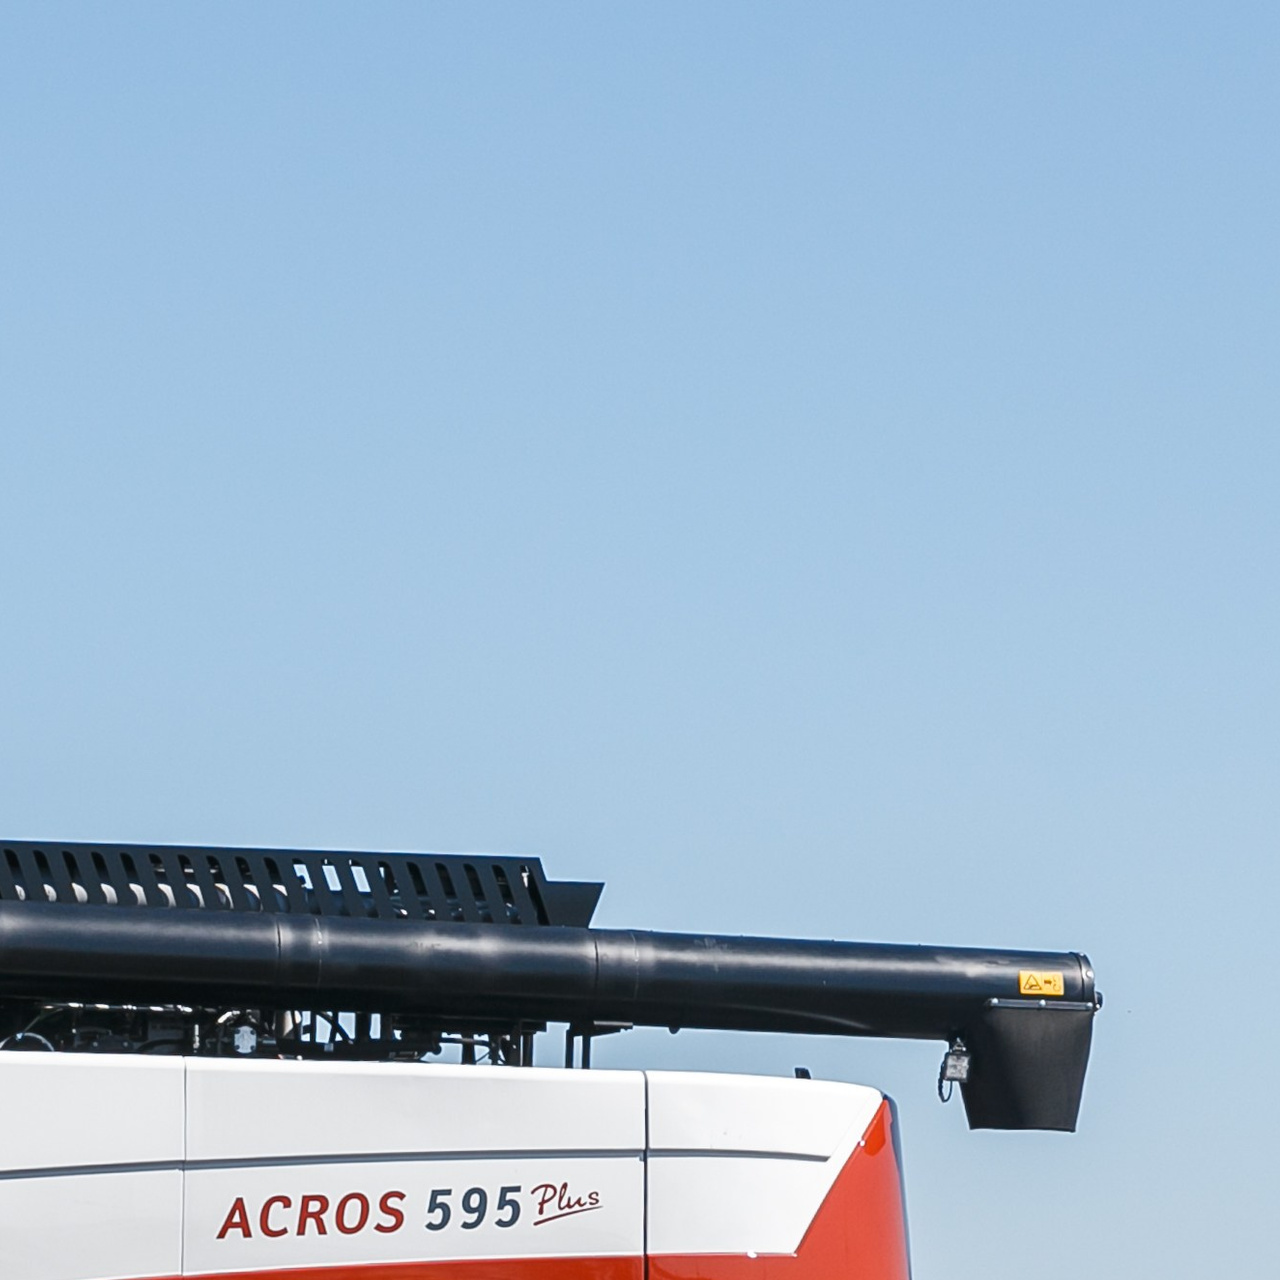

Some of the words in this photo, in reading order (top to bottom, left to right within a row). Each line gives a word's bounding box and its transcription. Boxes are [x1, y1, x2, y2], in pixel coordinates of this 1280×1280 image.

[216, 1190, 407, 1239] ACROS
[425, 1185, 522, 1231] 595
[530, 1181, 602, 1216] Plus
